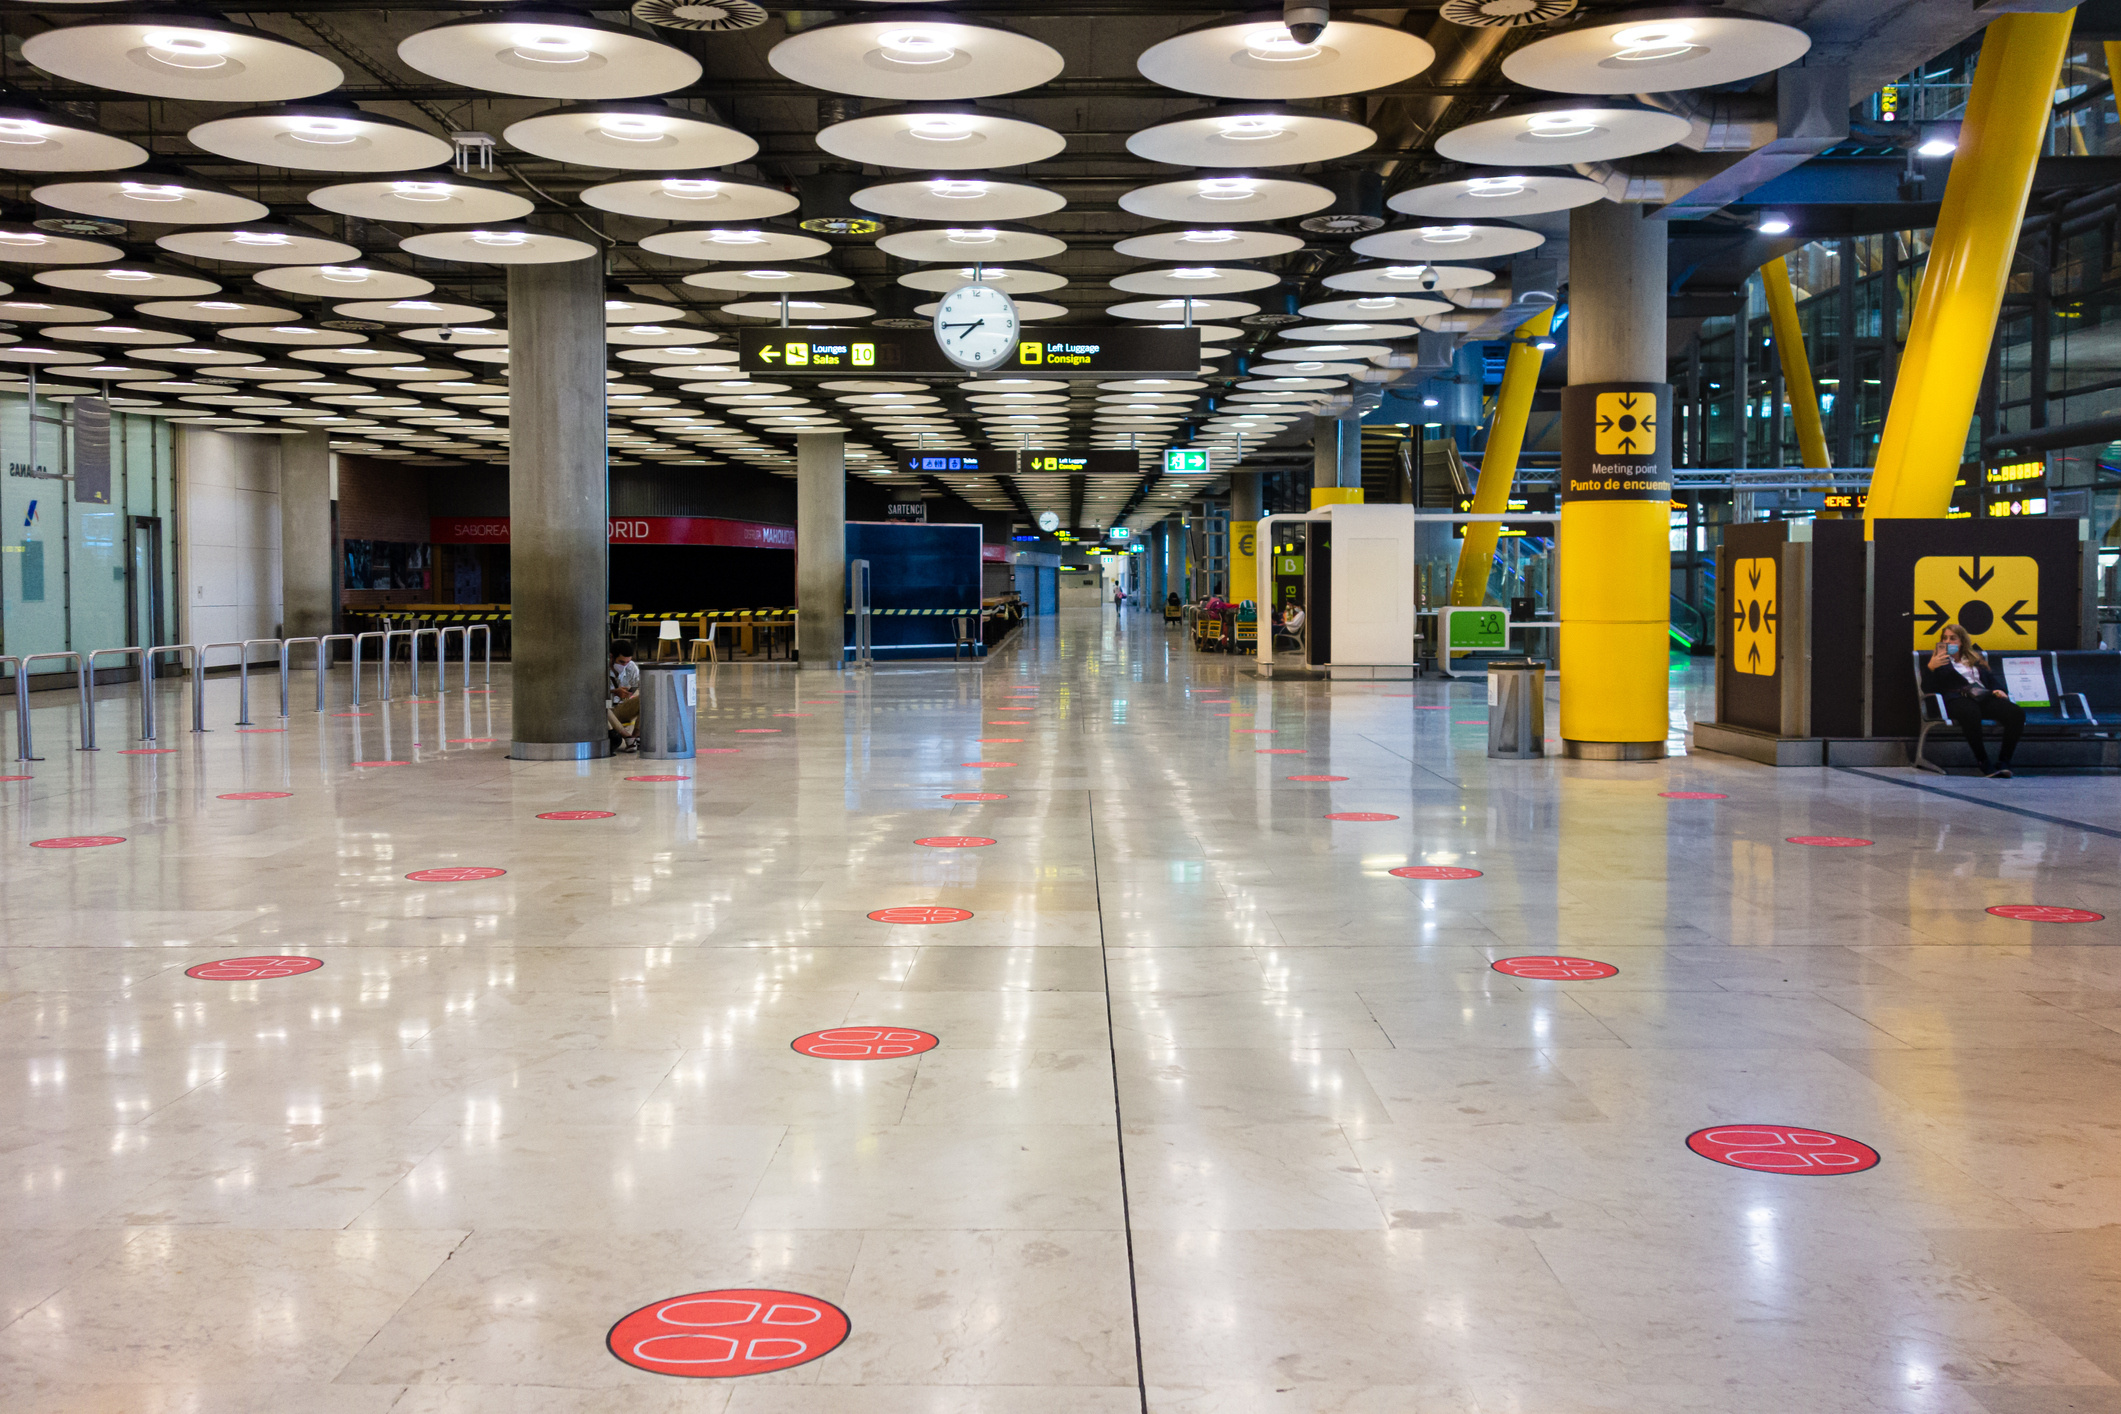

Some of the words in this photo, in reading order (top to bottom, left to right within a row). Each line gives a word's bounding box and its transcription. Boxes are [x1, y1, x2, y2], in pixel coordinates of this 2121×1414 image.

[1007, 320, 1012, 328] 3
[812, 344, 847, 354] Lounges
[1047, 343, 1064, 352] Left
[1066, 343, 1100, 354] Luggage
[812, 355, 840, 364] Salas
[854, 348, 872, 361] 10
[975, 352, 981, 360] 6
[1047, 354, 1091, 365] Consigna
[1592, 464, 1634, 475] Meeting
[1635, 464, 1658, 474] point
[1570, 480, 1601, 491] Punto
[1604, 478, 1620, 490] de
[454, 524, 509, 536] SABOREA
